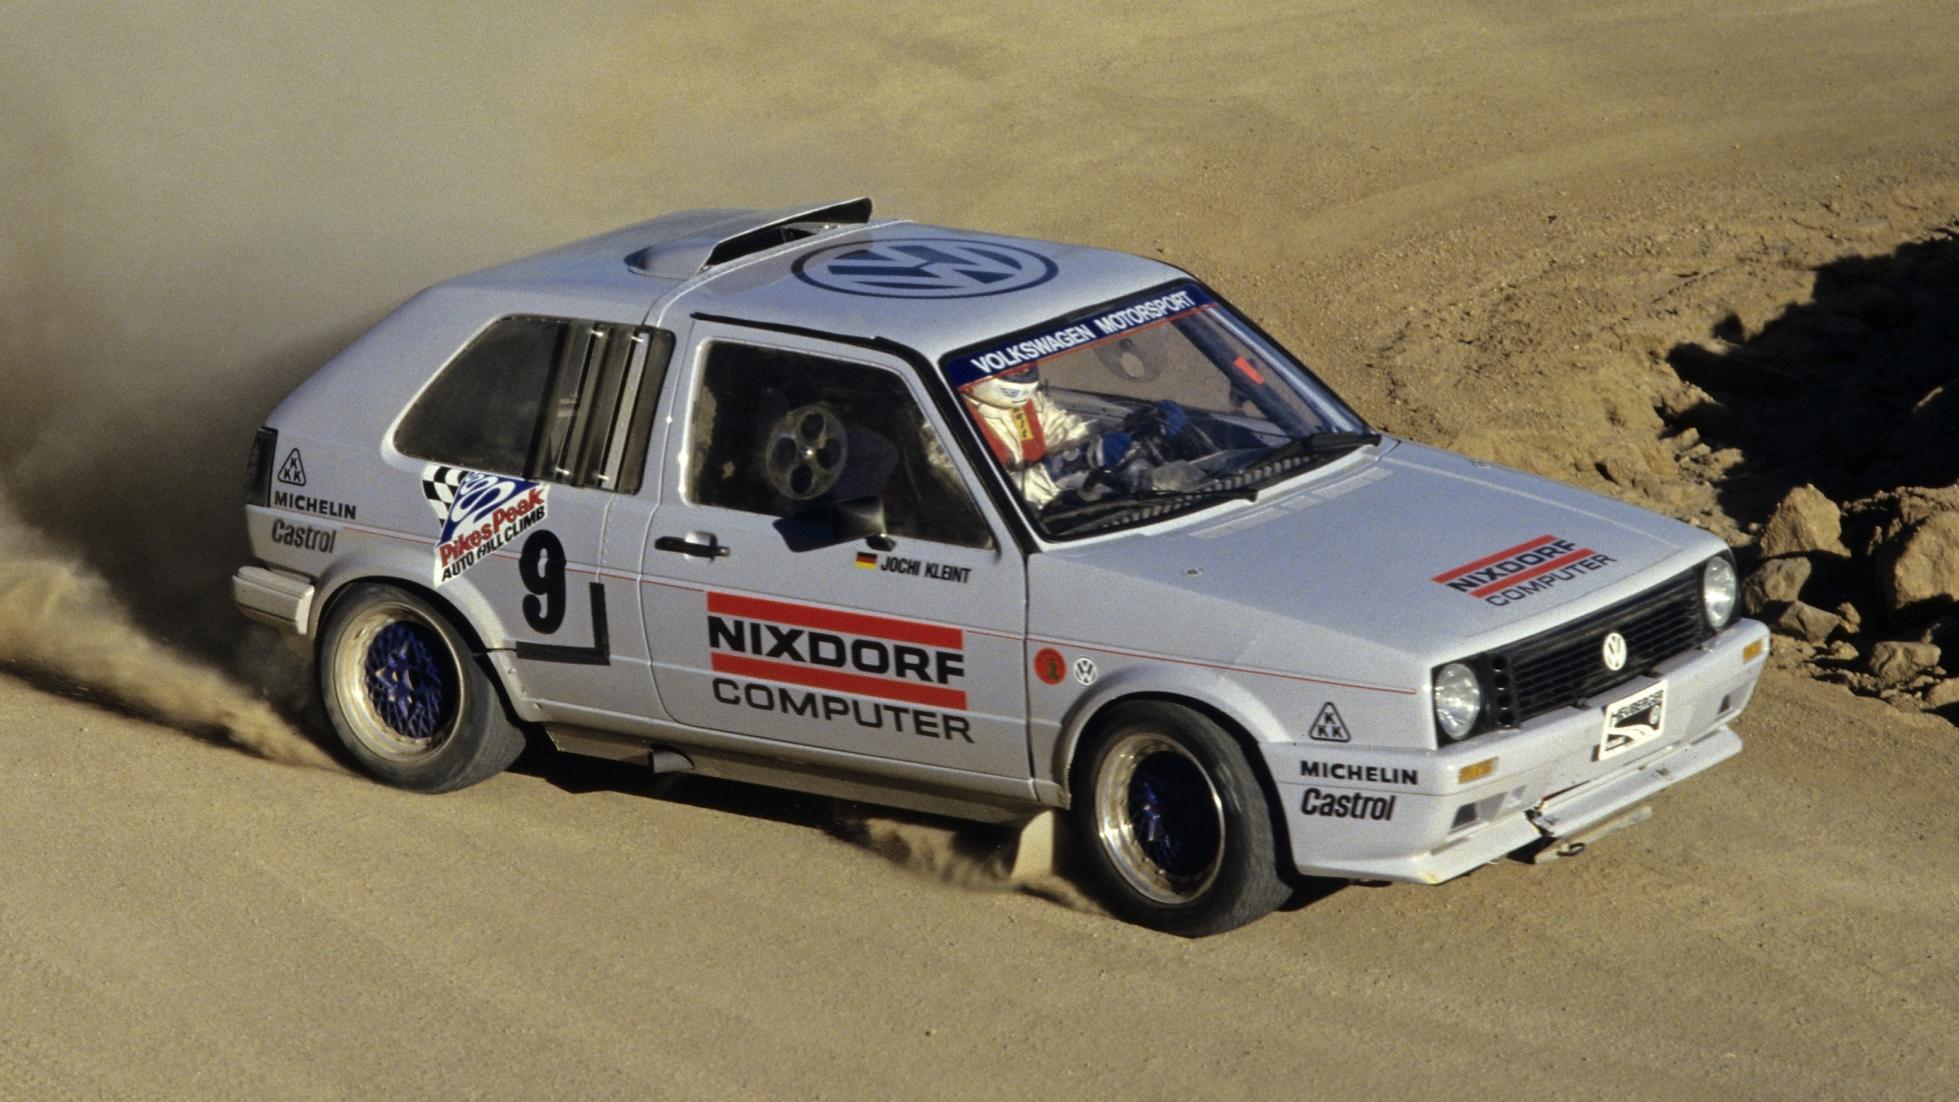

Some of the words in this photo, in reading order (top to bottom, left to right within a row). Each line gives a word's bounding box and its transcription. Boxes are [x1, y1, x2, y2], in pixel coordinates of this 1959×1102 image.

[970, 324, 1097, 374] VOLKSWAGEN
[1094, 291, 1196, 335] MOTORSPORT
[274, 490, 357, 520] MICHELIN
[439, 523, 493, 568] Pikes
[492, 488, 545, 533] Peak
[271, 518, 337, 554] Castrol
[442, 551, 475, 582] AUTO
[477, 535, 505, 560] HILL
[504, 505, 546, 542] CLIMB
[518, 530, 567, 635] 9
[880, 556, 921, 577] JOCHI
[924, 561, 972, 584] KLEINT
[1446, 539, 1577, 593] NIXDORF
[1484, 553, 1618, 607] COMPUTER
[707, 615, 965, 685] NIXDORF
[712, 677, 976, 745] COMPUTER
[1301, 760, 1418, 785] MICHELIN
[1301, 787, 1397, 821] Castrol
